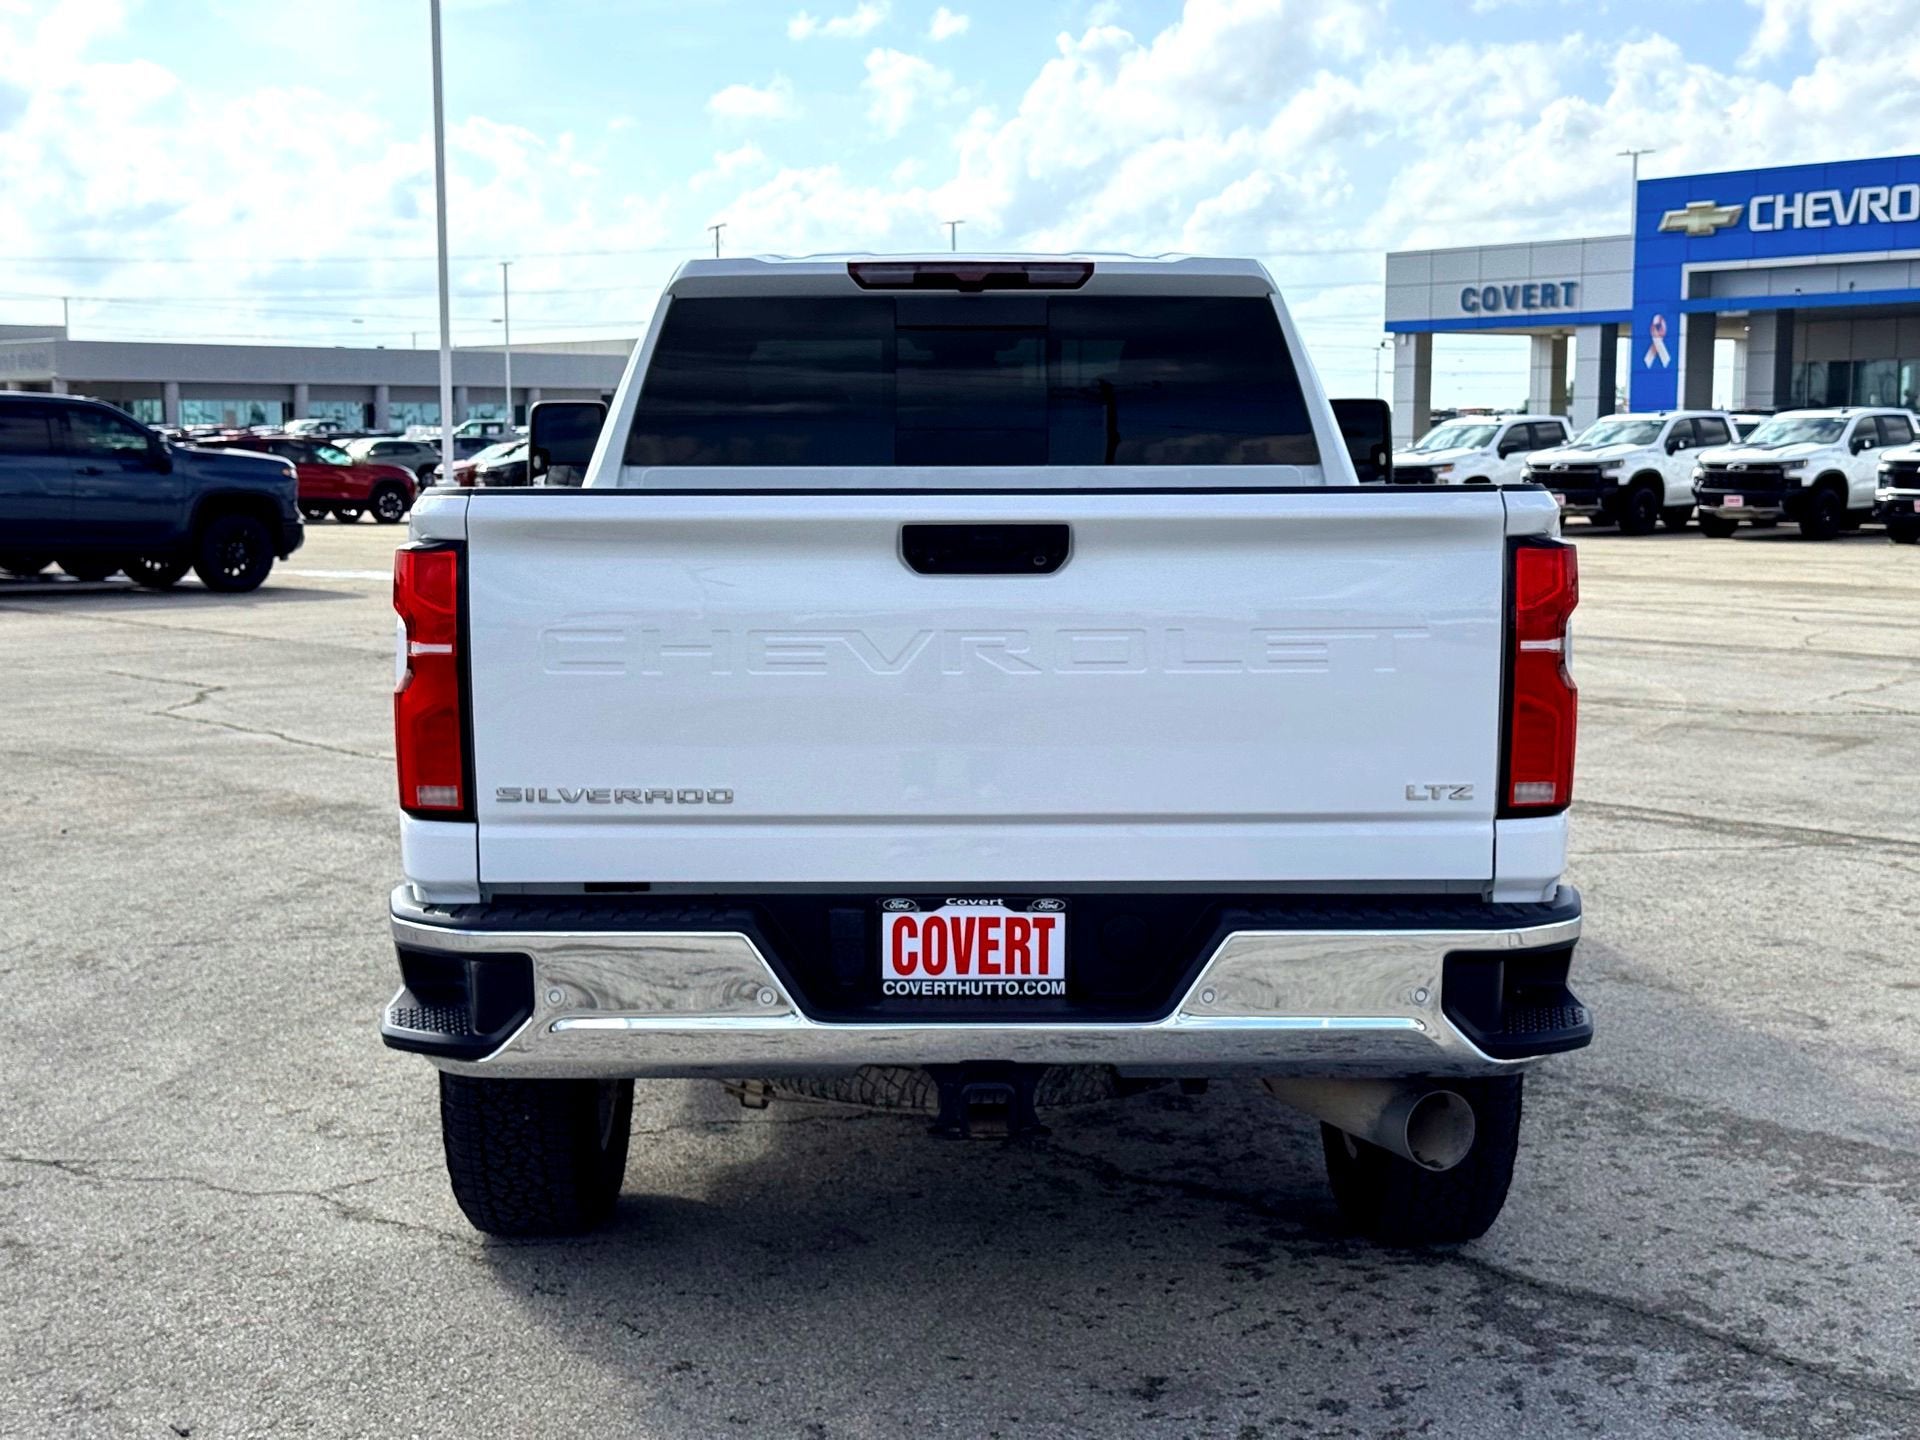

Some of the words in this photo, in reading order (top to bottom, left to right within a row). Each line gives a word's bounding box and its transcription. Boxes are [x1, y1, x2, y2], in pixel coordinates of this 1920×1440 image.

[1749, 183, 1920, 232] CHEVRO
[1461, 282, 1578, 312] COVERT
[541, 629, 1428, 676] CHEVROLET
[496, 786, 734, 804] SILVERADO
[1405, 784, 1474, 801] LTZ
[945, 898, 1004, 906] Covert
[892, 916, 1056, 976] COVERT
[882, 981, 1066, 995] COVERTHUTTO.COM
